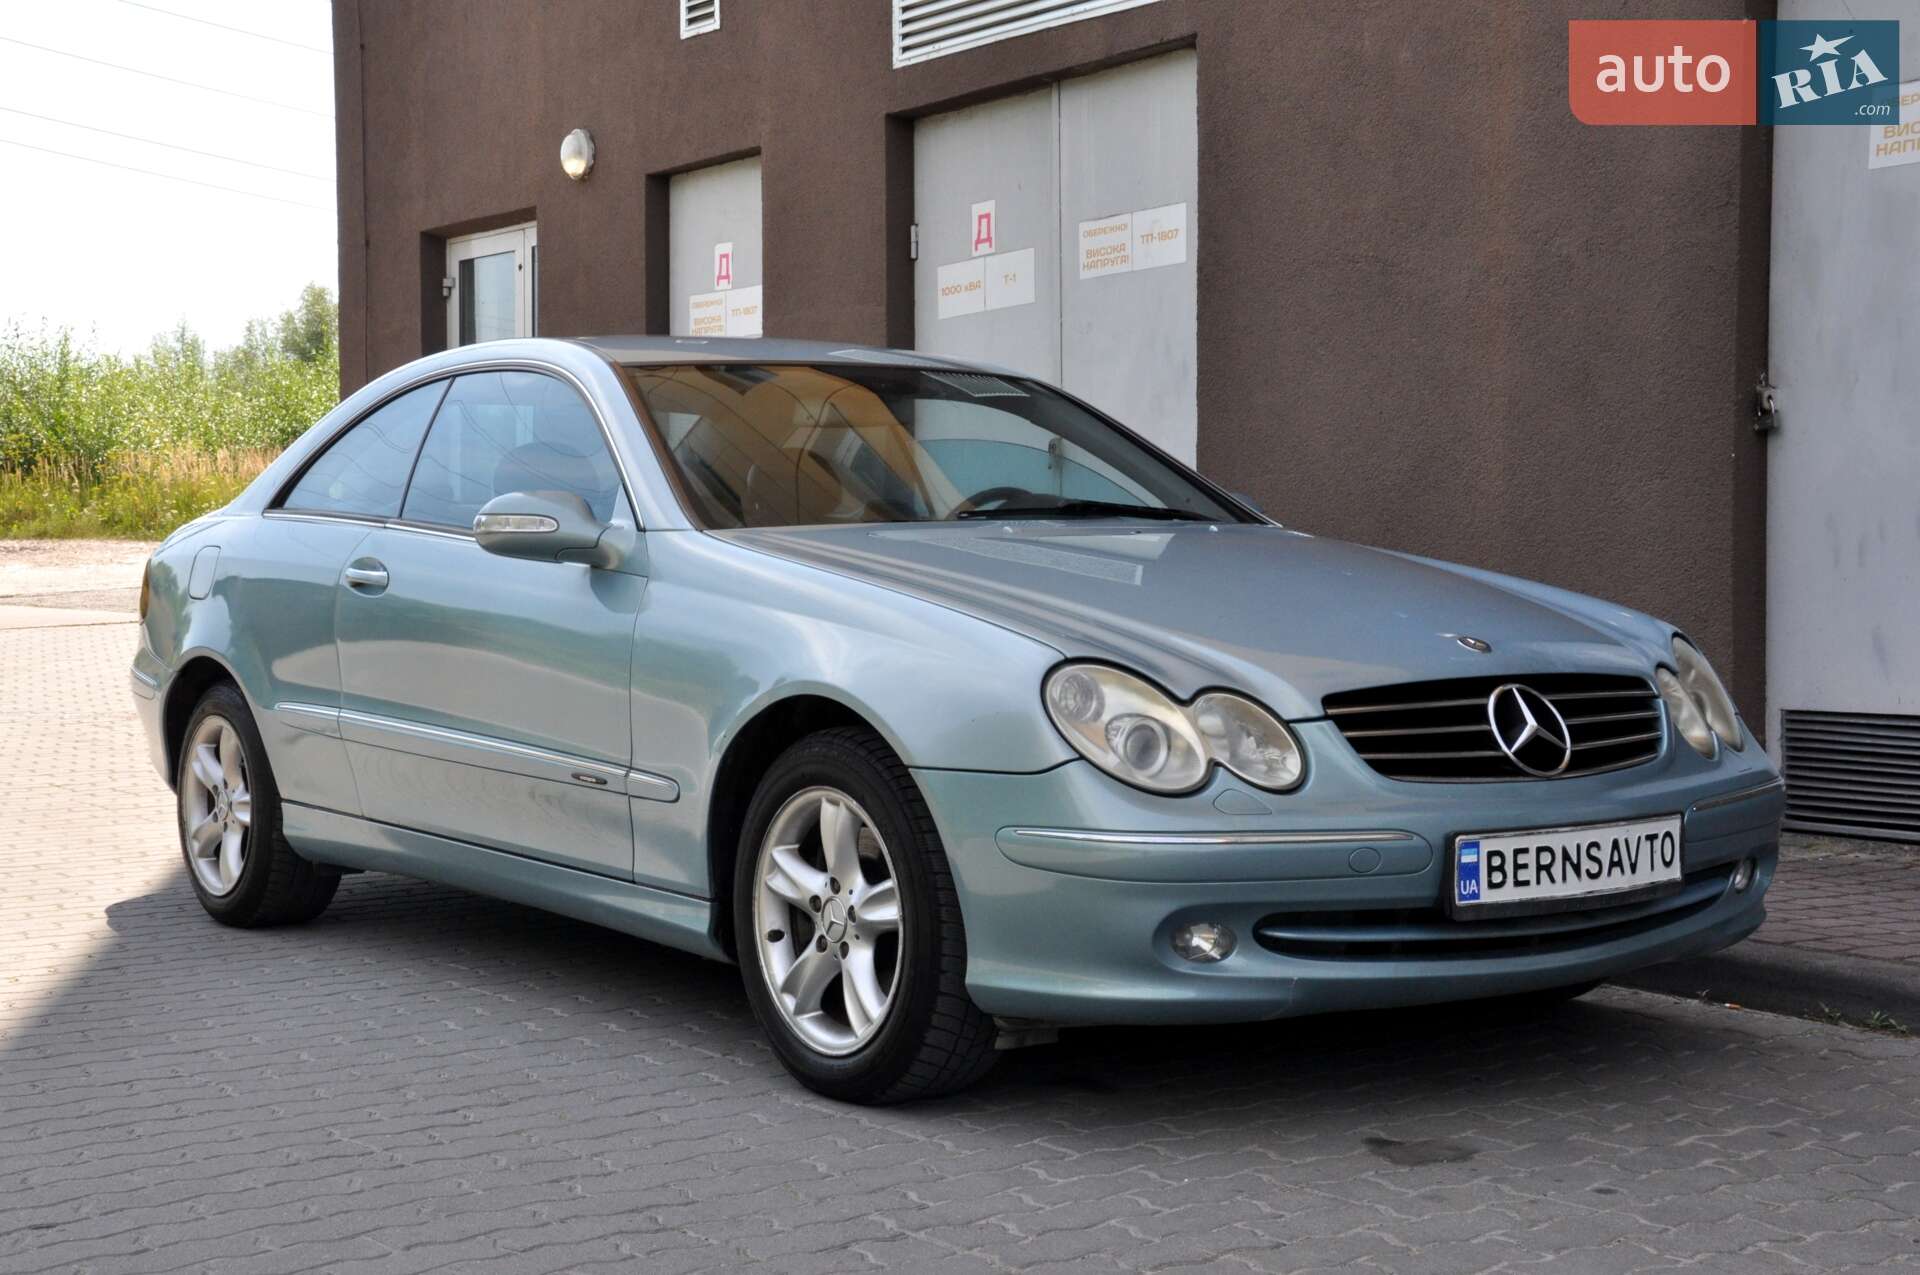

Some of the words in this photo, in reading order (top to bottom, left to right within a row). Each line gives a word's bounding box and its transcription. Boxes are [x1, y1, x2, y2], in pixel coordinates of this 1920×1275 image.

[1876, 137, 1920, 157] НАП
[974, 212, 993, 252] Д
[1086, 242, 1126, 258] ВИСОКА
[716, 253, 731, 287] Д
[941, 284, 962, 297] 1000
[1486, 830, 1676, 890] BERNSAVTO
[1460, 879, 1479, 896] UA
